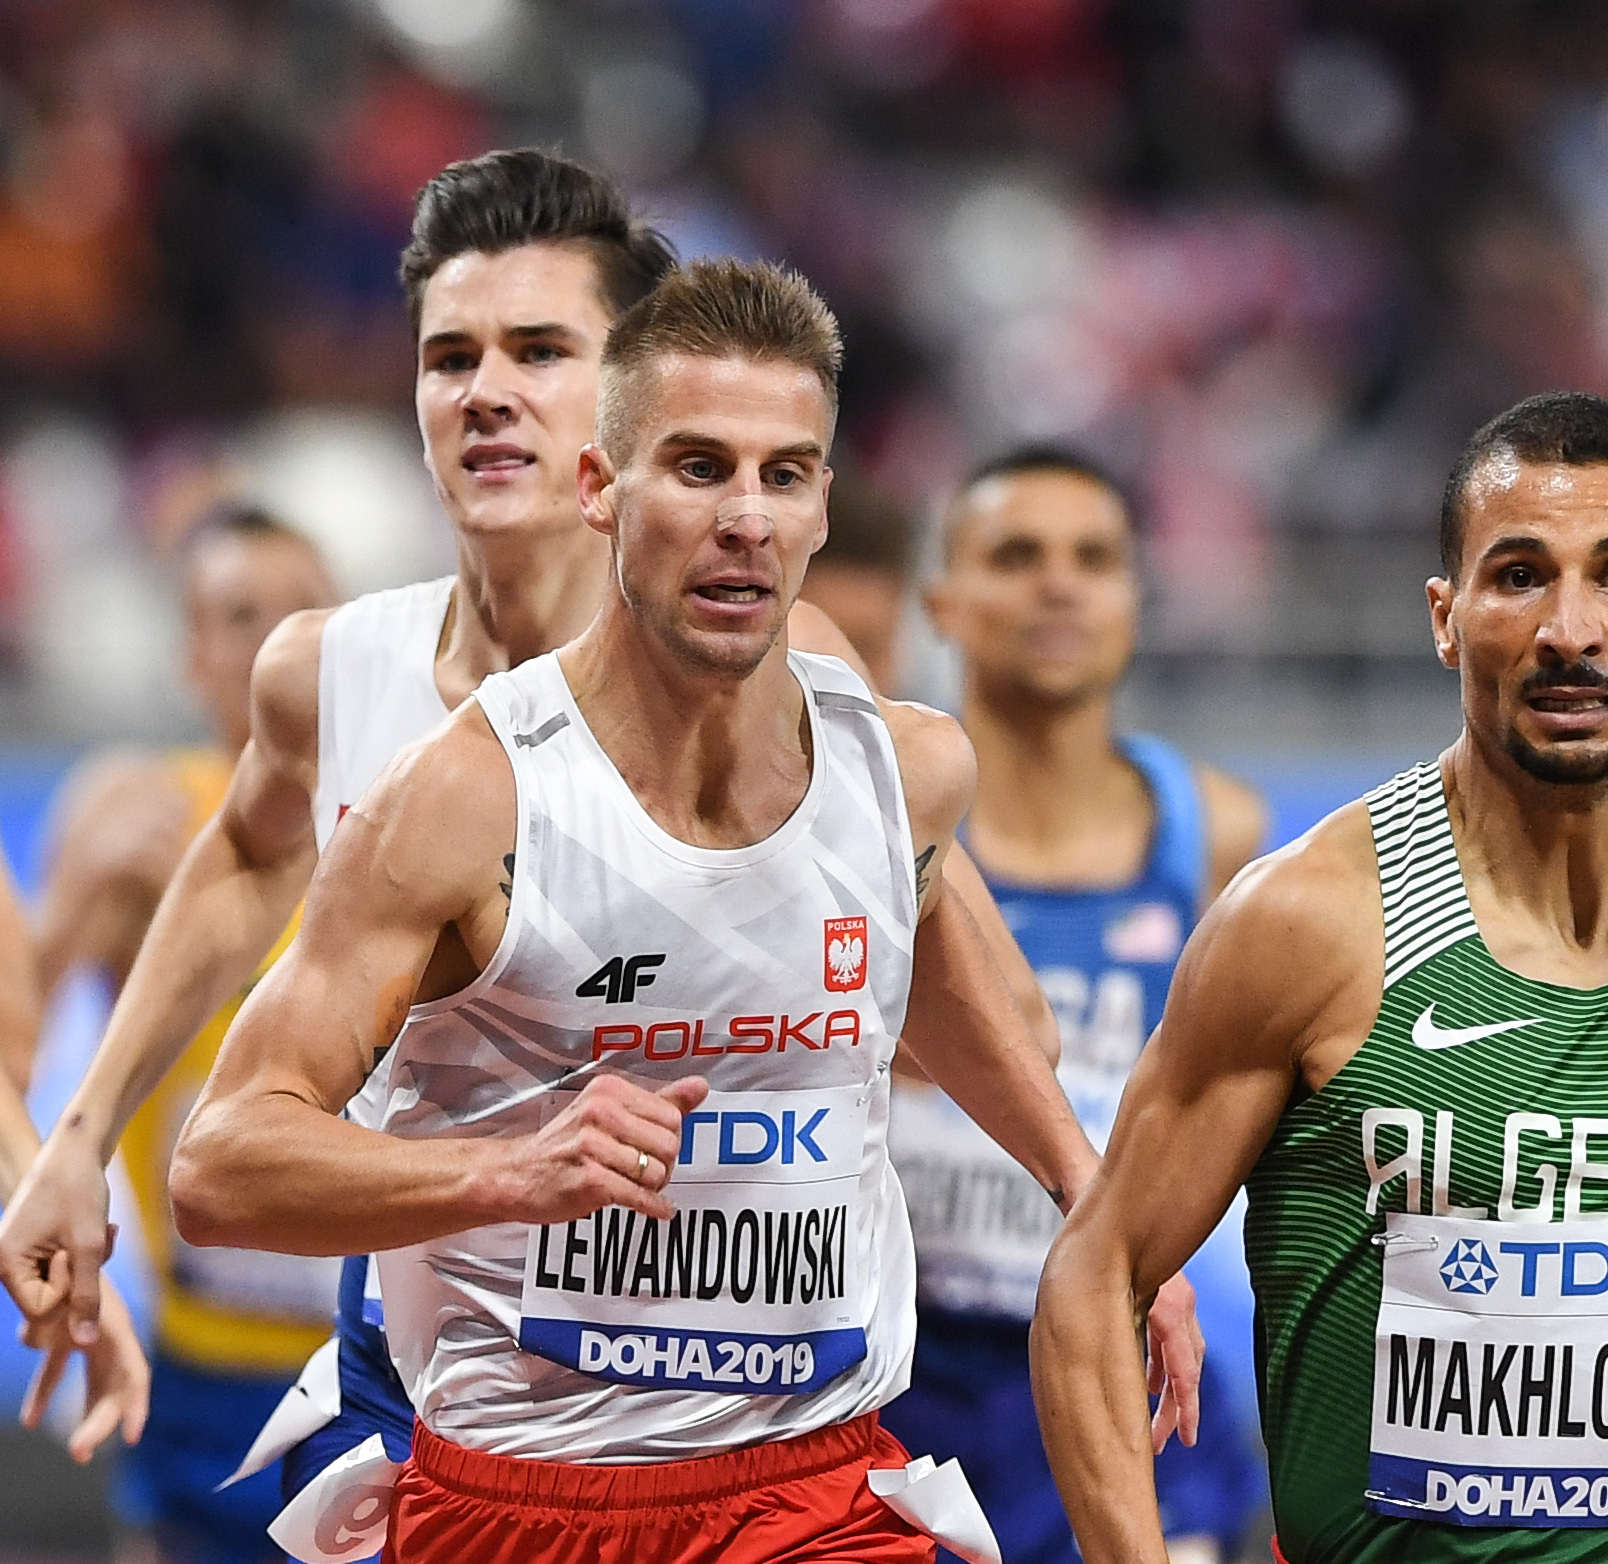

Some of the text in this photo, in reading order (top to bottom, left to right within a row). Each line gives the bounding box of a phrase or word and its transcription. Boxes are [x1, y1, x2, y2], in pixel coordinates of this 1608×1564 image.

[827, 919, 865, 932] POLSKA
[592, 1009, 860, 1062] POLSKA
[678, 1108, 831, 1165] TDK
[535, 1204, 848, 1305] LEWANDOWSKI
[578, 1329, 815, 1386] DOHA2019
